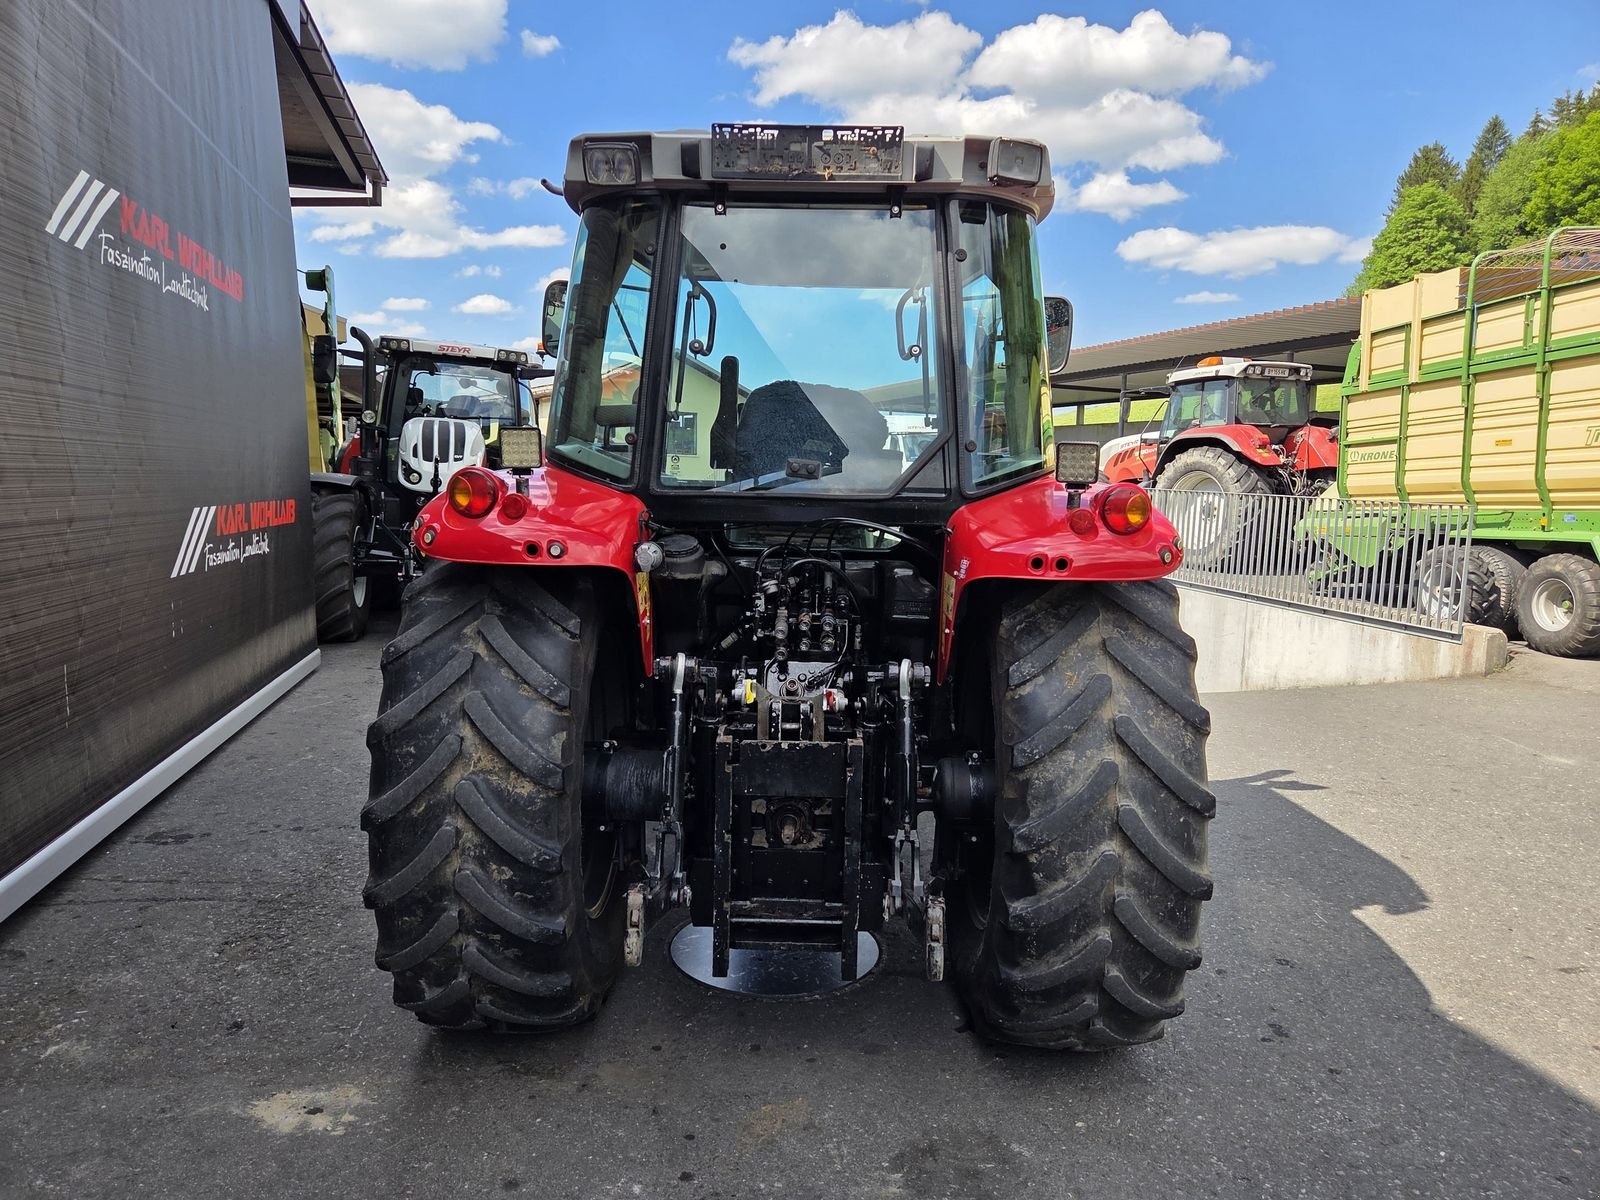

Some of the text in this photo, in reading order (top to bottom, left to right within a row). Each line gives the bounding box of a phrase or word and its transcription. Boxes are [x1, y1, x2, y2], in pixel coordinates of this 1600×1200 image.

[120, 193, 174, 260] KARL
[98, 229, 209, 312] Faszination Landtechnik
[437, 344, 472, 354] STEYR
[1360, 450, 1395, 461] KRONE
[216, 498, 295, 536] KARL WOHLLAIB
[204, 539, 240, 572] Faszination
